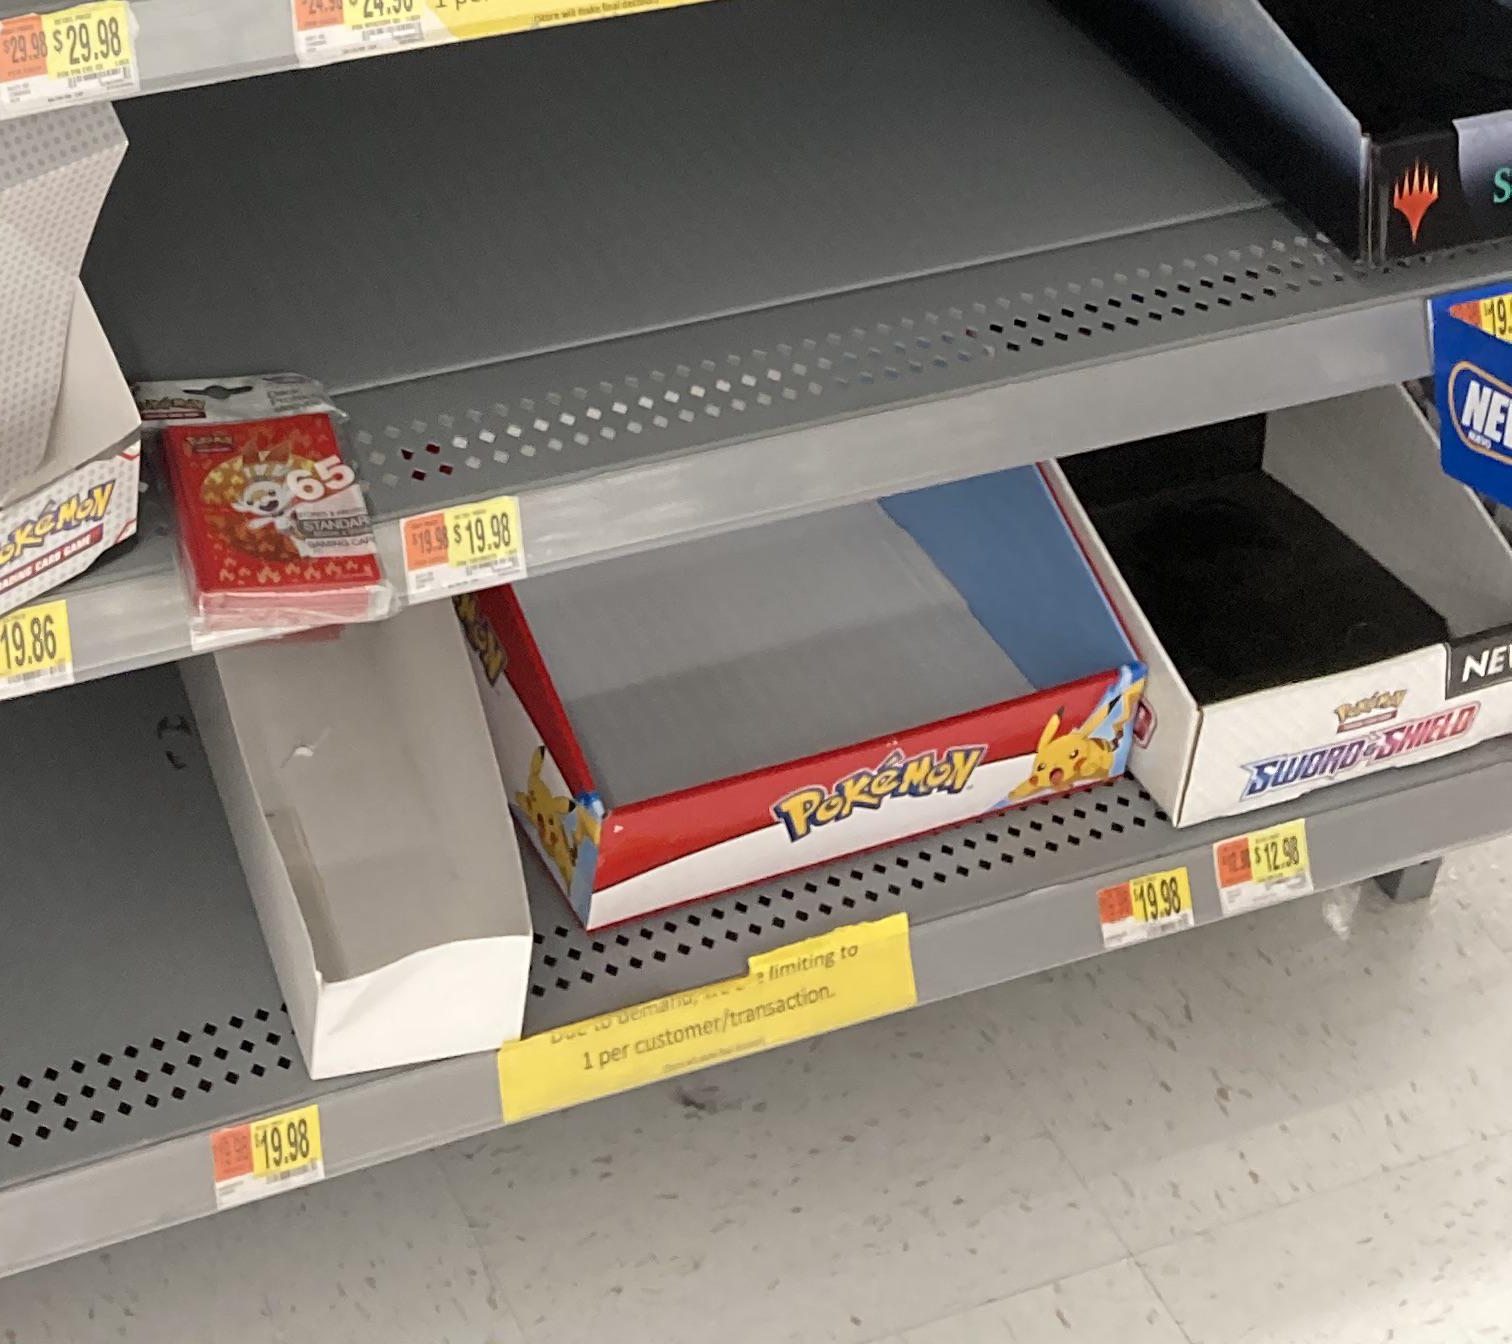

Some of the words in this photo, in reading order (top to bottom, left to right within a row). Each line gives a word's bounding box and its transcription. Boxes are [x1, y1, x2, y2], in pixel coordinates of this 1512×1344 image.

[53, 16, 121, 66] $29.98
[287, 455, 355, 501] 65
[454, 512, 511, 554] $19.98
[35, 553, 61, 576] CARD
[1247, 740, 1366, 796] SWORD
[1375, 704, 1476, 761] SHIELD
[1134, 877, 1181, 922] $19.98
[769, 949, 835, 982] limiting
[839, 944, 859, 961] to
[583, 1050, 592, 1070] 1
[599, 1044, 629, 1070] per
[634, 983, 835, 1055] customer/transaction.
[254, 1119, 310, 1169] $19.98
